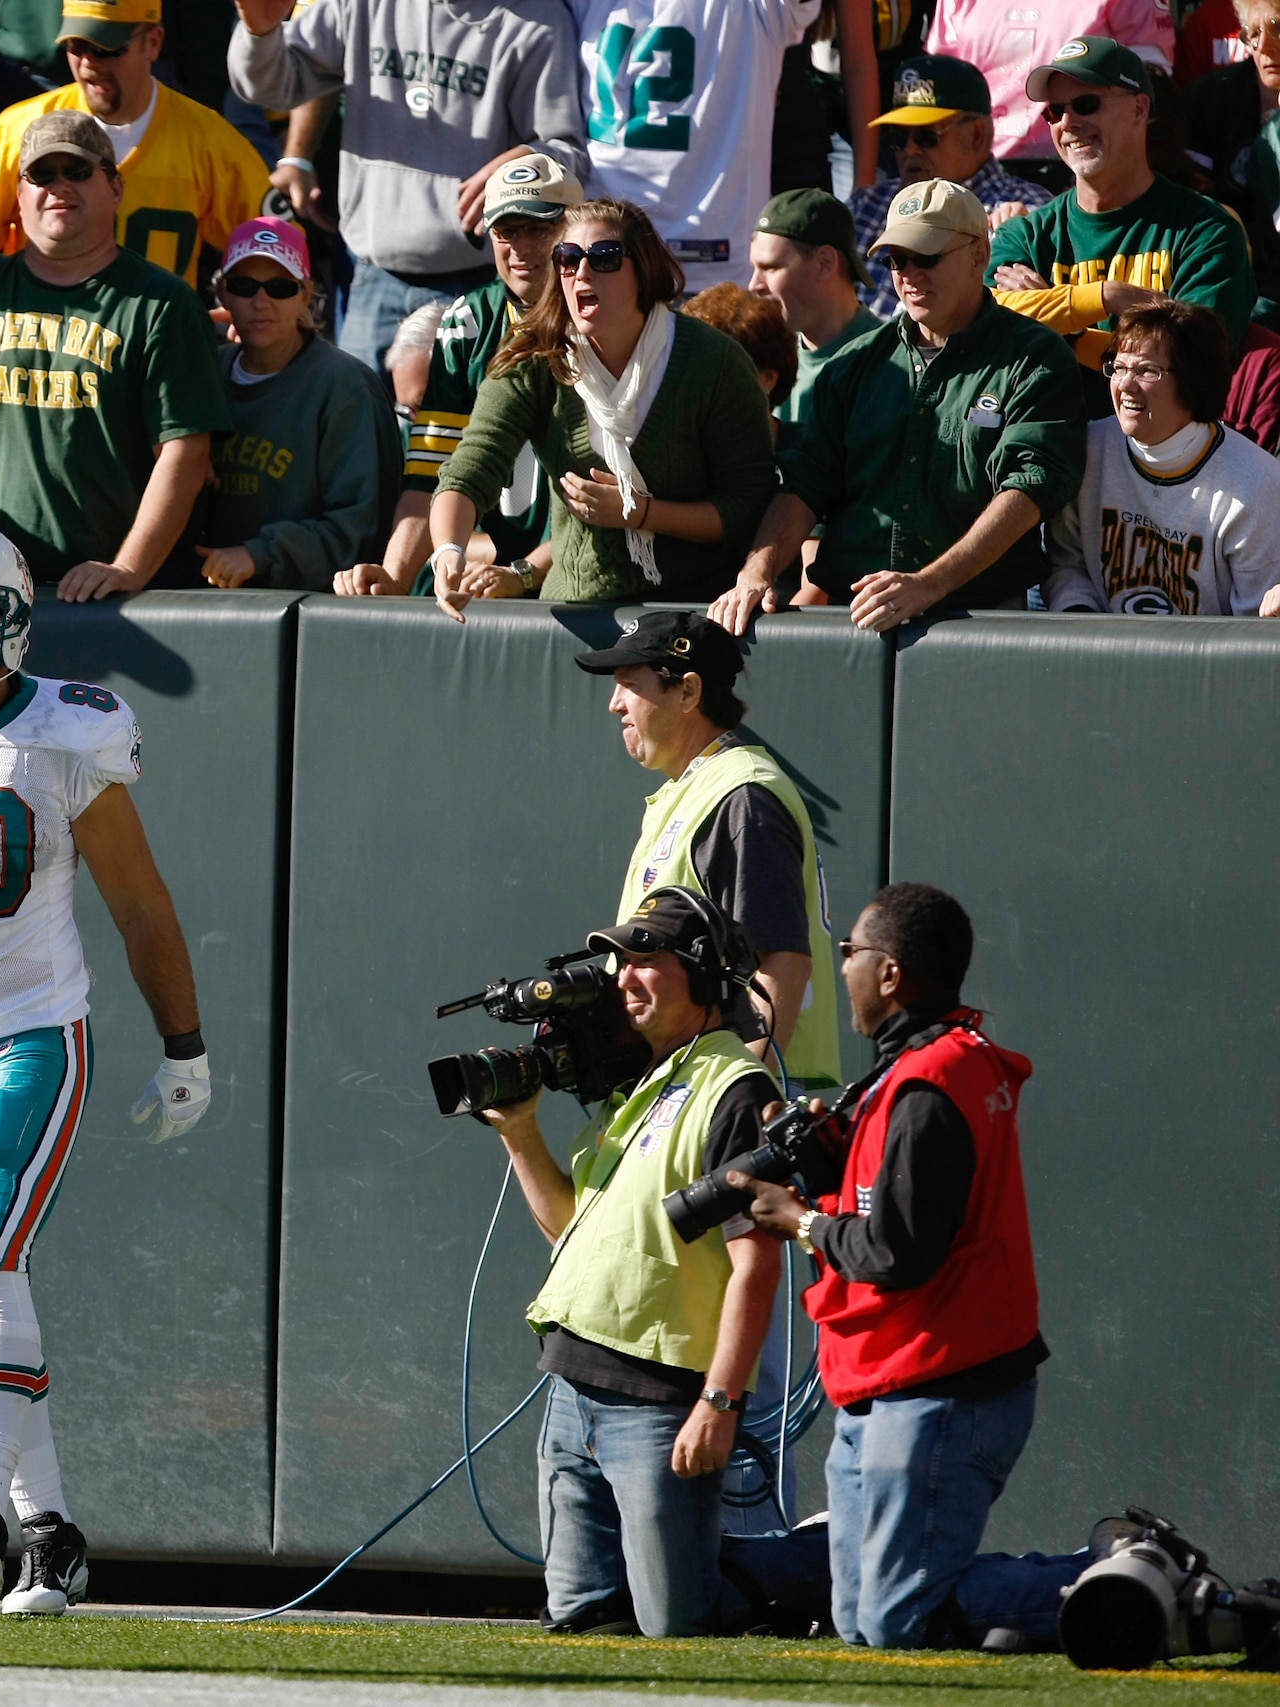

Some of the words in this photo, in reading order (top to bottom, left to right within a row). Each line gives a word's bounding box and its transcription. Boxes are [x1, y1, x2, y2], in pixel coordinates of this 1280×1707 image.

[588, 22, 695, 152] 12
[500, 186, 540, 199] PACKERS
[62, 316, 122, 373] BAY
[1121, 511, 1161, 533] GREEN
[1164, 527, 1188, 543] BAY
